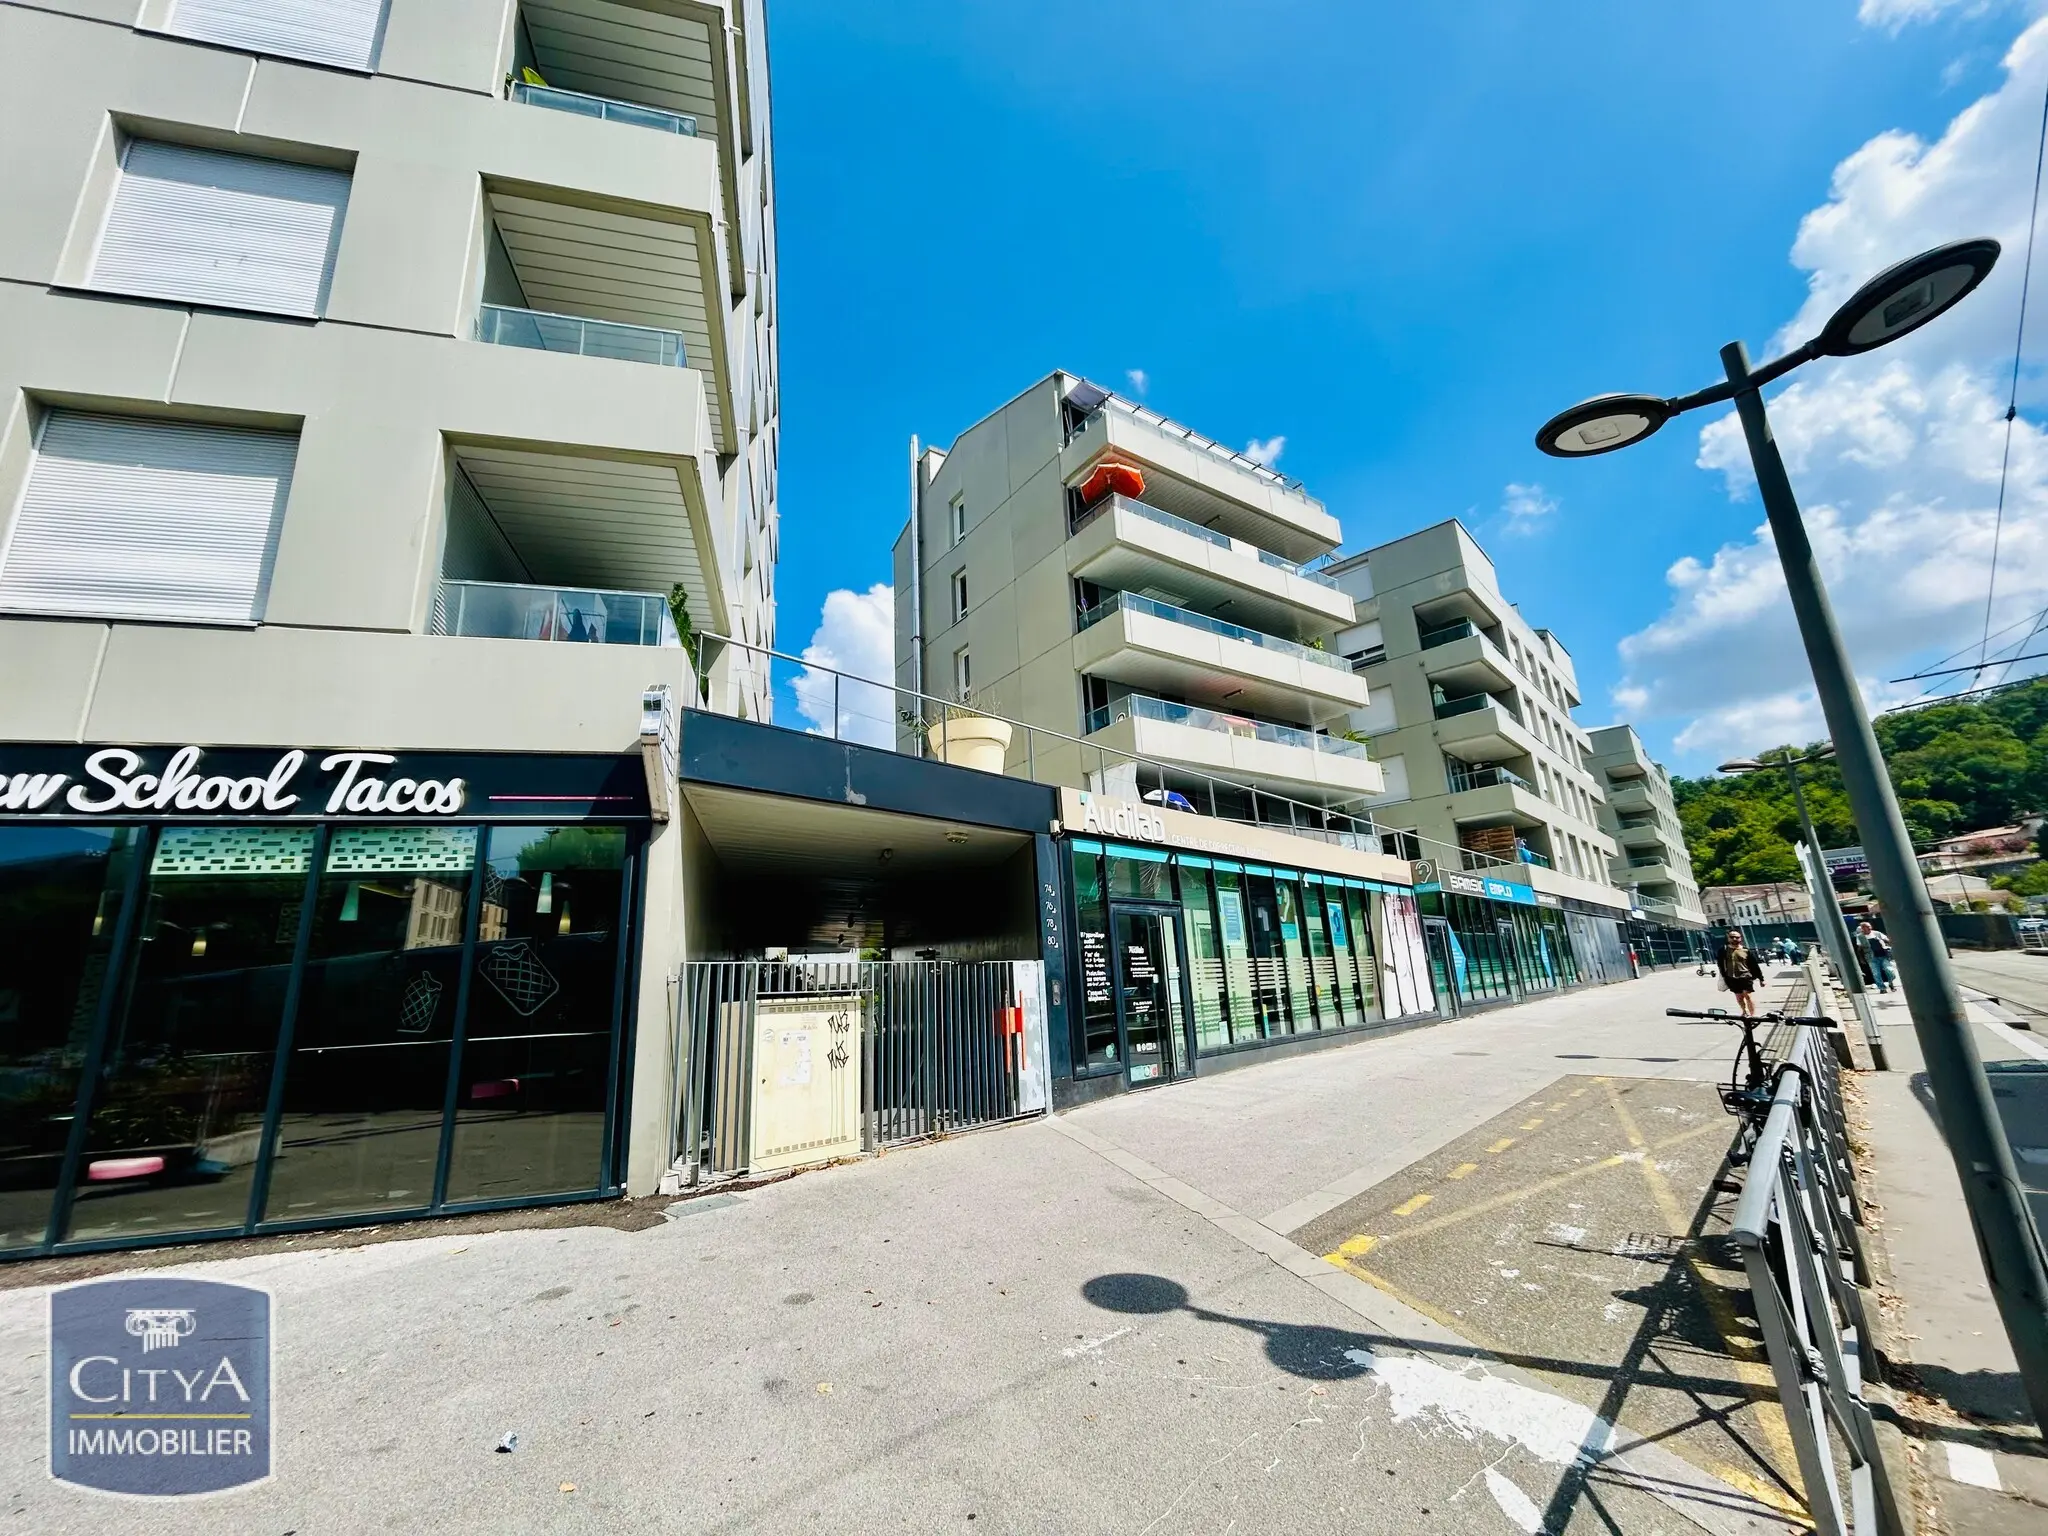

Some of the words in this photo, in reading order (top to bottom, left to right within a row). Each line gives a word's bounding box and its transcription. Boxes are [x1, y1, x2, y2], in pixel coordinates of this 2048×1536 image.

[66, 745, 303, 812] School
[321, 752, 464, 814] Tacos
[1083, 793, 1165, 843] Audilab
[1044, 883, 1052, 893] 74
[1449, 874, 1486, 894] SAMSIC
[1045, 901, 1054, 911] 76
[1046, 918, 1054, 928] 78
[1047, 935, 1056, 945] 80
